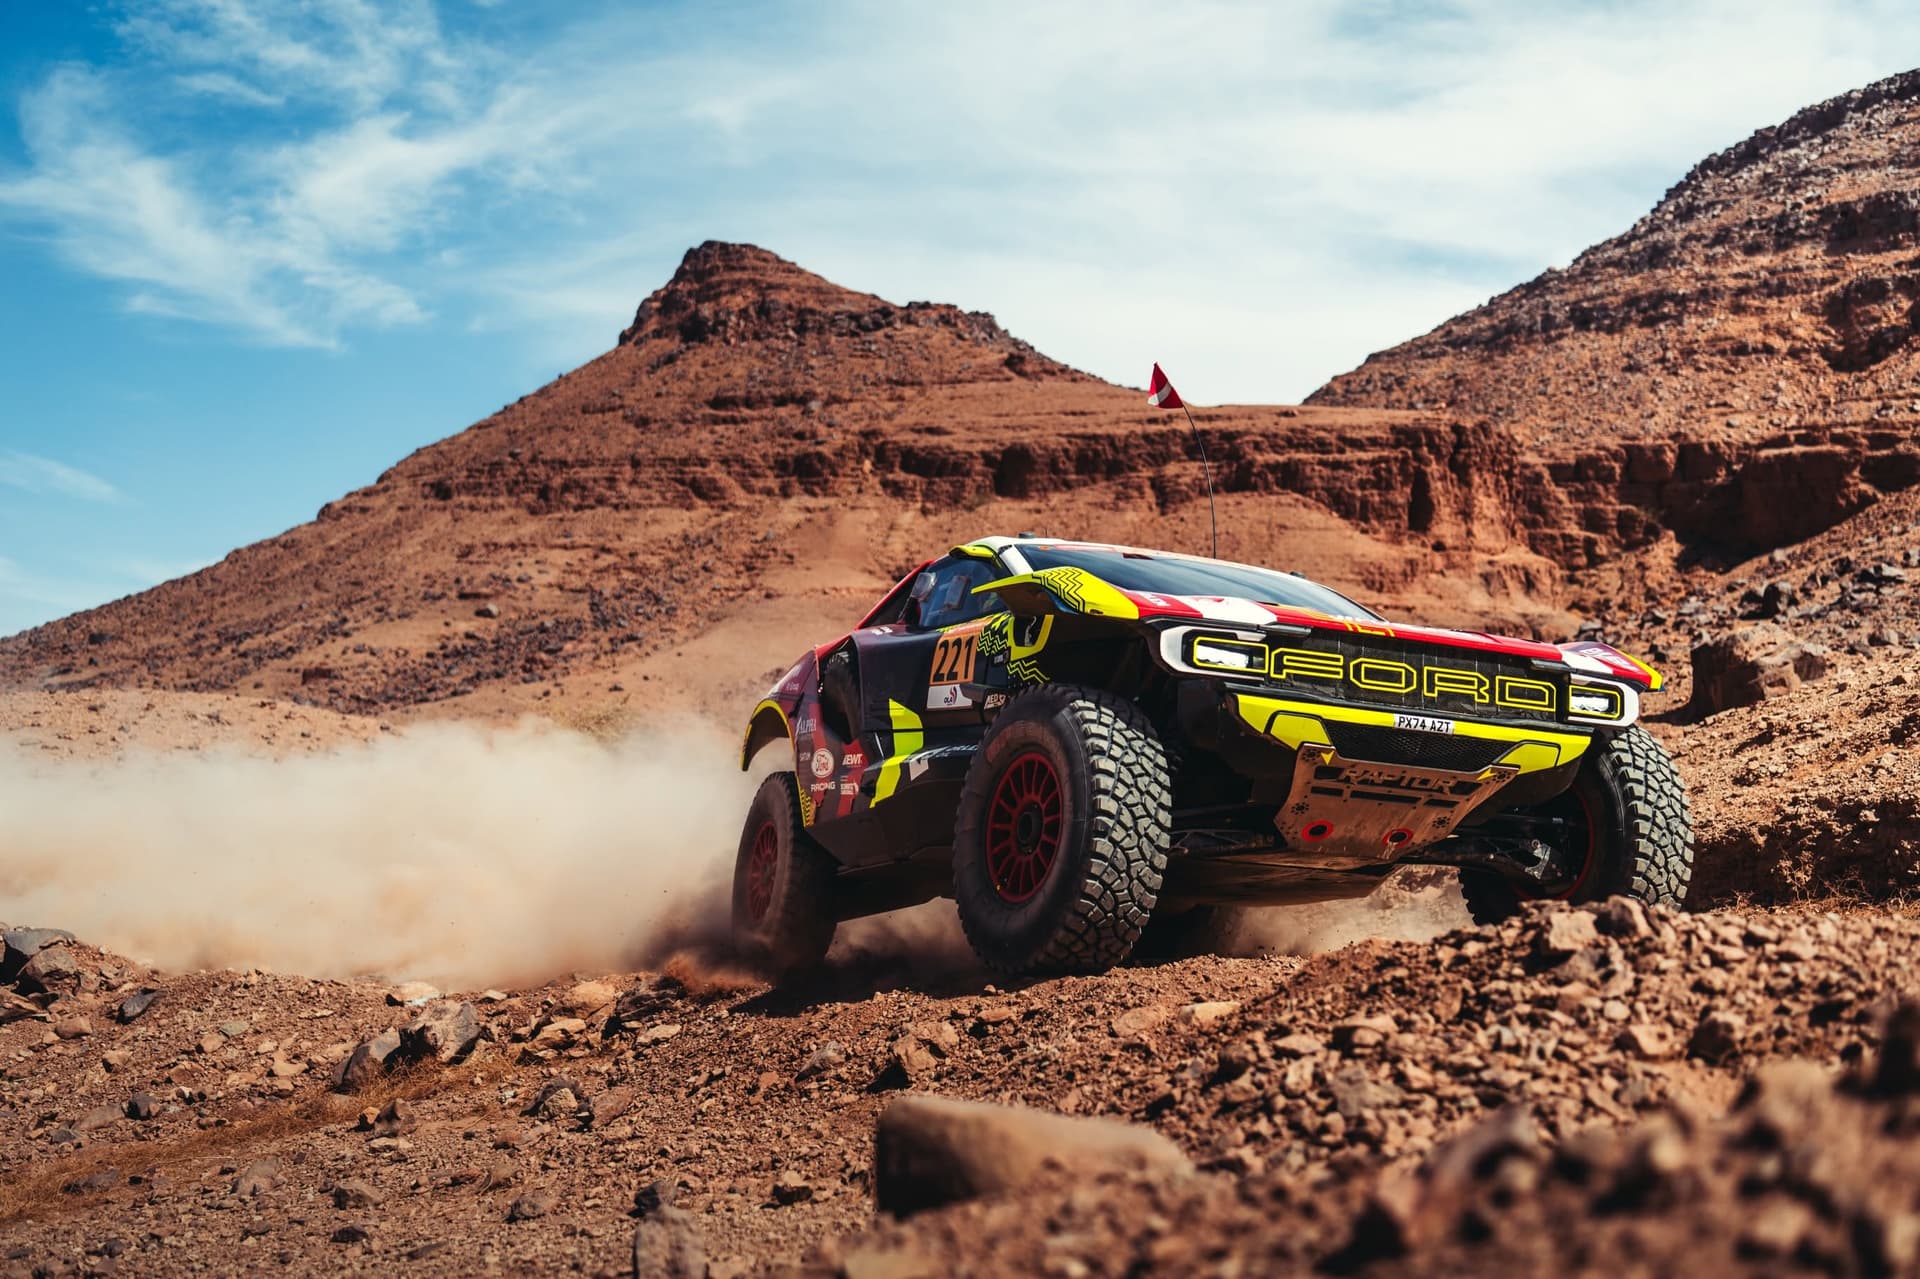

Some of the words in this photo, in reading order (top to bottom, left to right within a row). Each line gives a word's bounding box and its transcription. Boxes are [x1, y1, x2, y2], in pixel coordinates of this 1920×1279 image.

[932, 636, 975, 682] 221
[1270, 647, 1557, 713] FORD
[1398, 716, 1427, 731] PX74
[1429, 721, 1451, 734] AZT
[810, 781, 836, 793] RACING
[1339, 768, 1456, 794] RAPTOR
